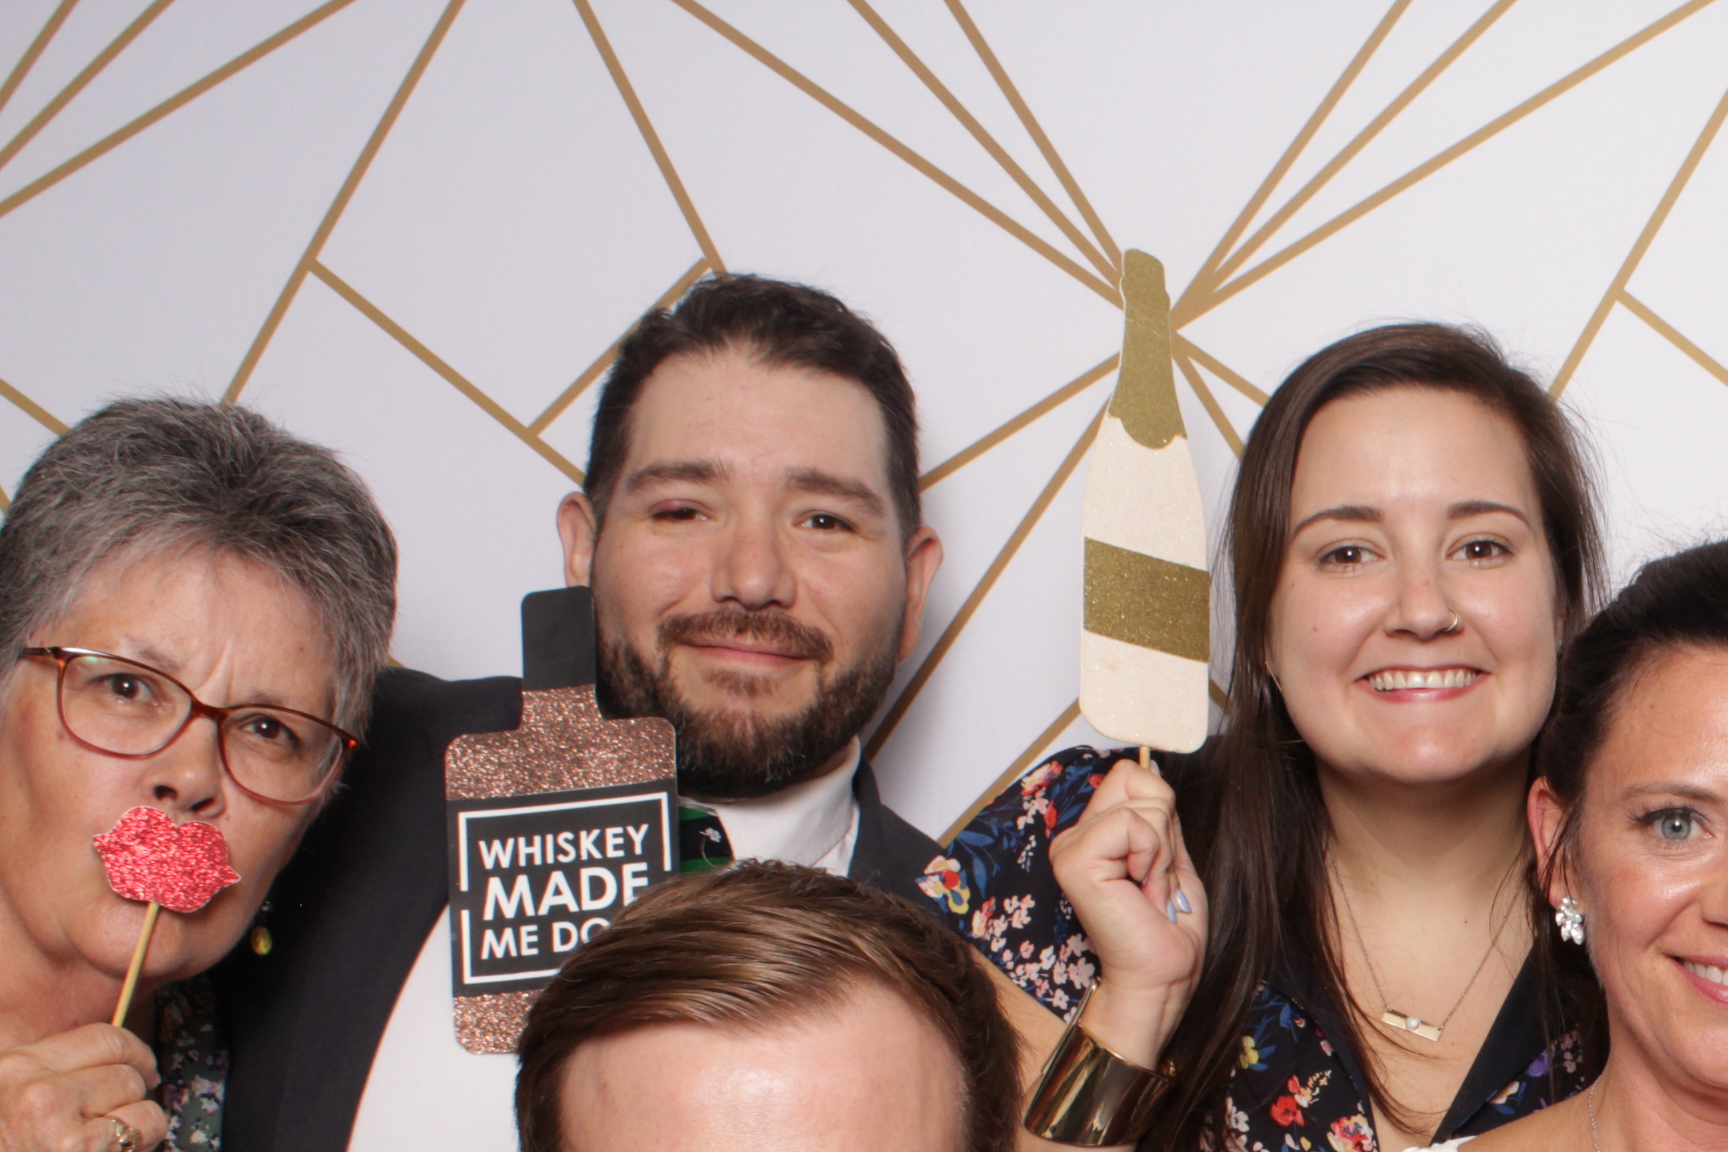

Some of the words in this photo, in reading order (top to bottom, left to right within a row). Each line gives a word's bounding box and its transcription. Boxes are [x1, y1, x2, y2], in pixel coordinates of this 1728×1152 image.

[478, 823, 649, 870] WHISKEY
[482, 862, 649, 921] MADE
[481, 925, 539, 960] ME
